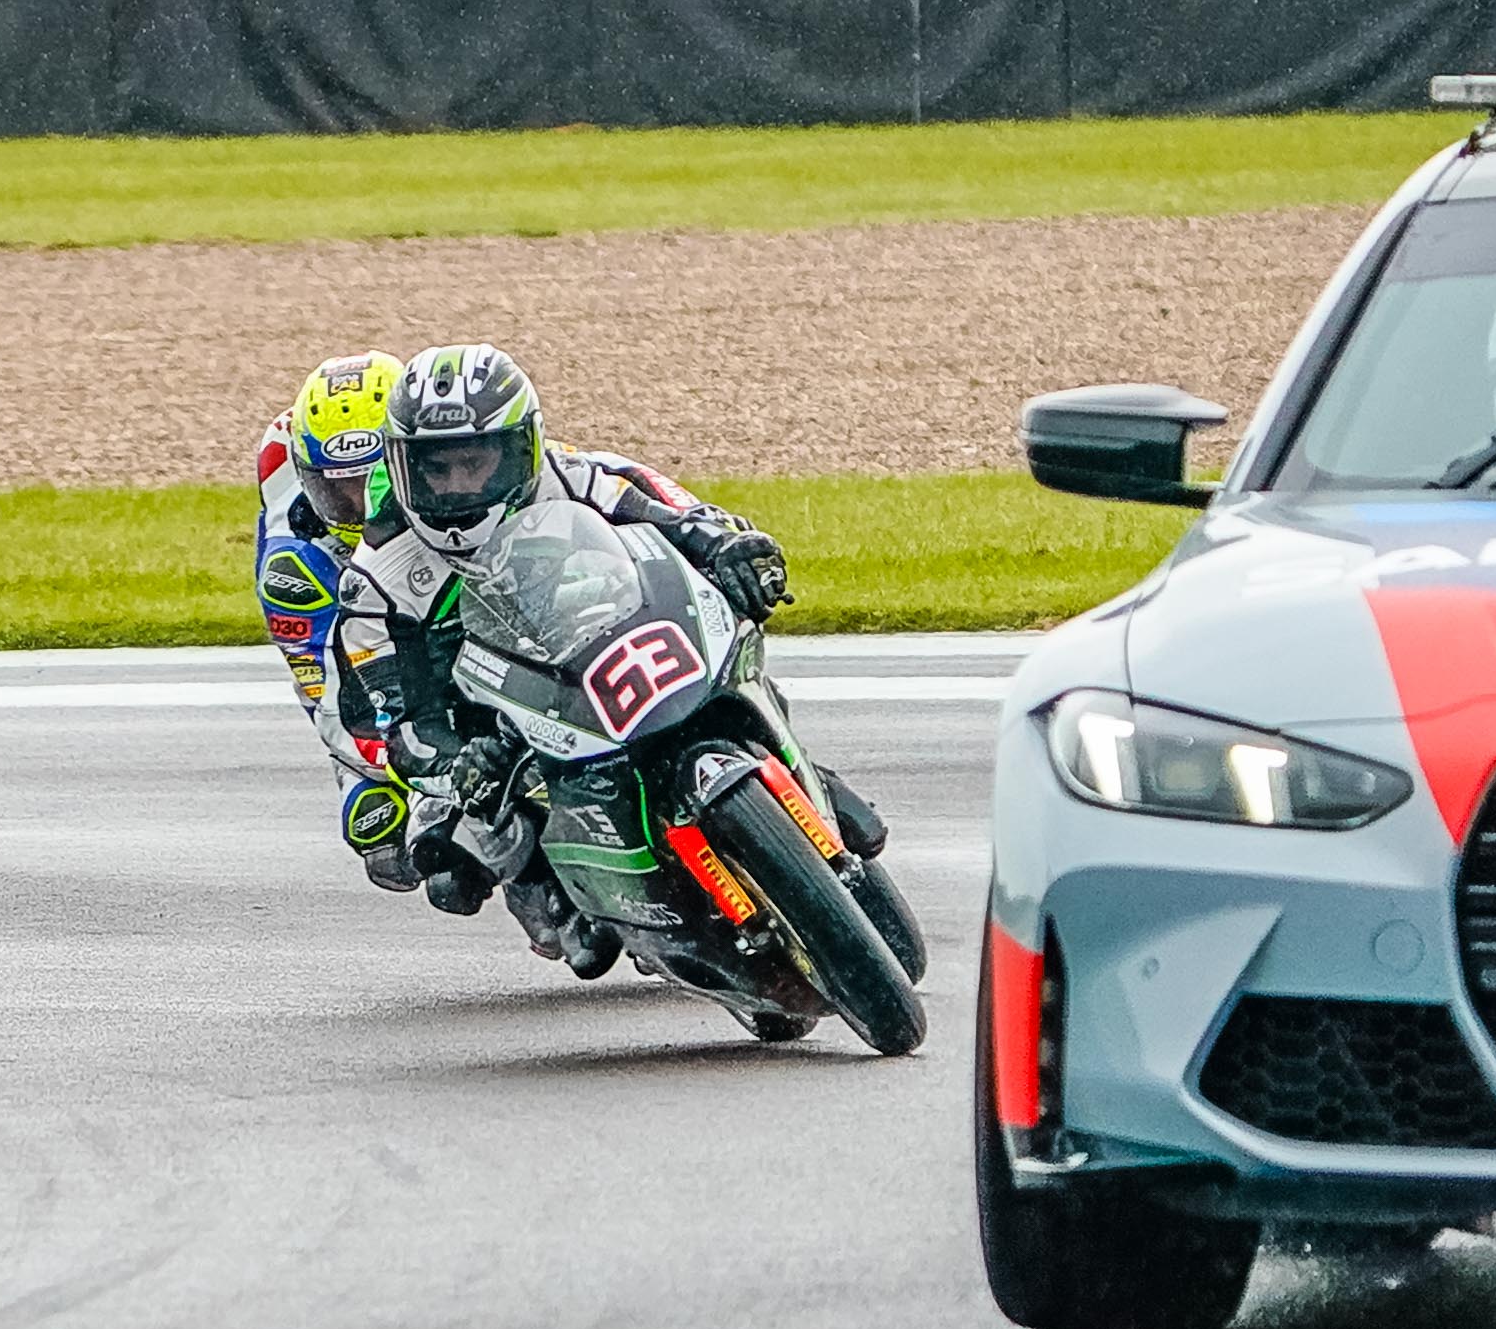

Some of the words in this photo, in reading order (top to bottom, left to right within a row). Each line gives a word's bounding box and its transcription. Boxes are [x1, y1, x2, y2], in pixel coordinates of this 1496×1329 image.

[589, 625, 701, 734] 63
[525, 715, 578, 750] Moto4
[783, 790, 838, 855] PIRELLI
[699, 848, 754, 917] PIRELLI
